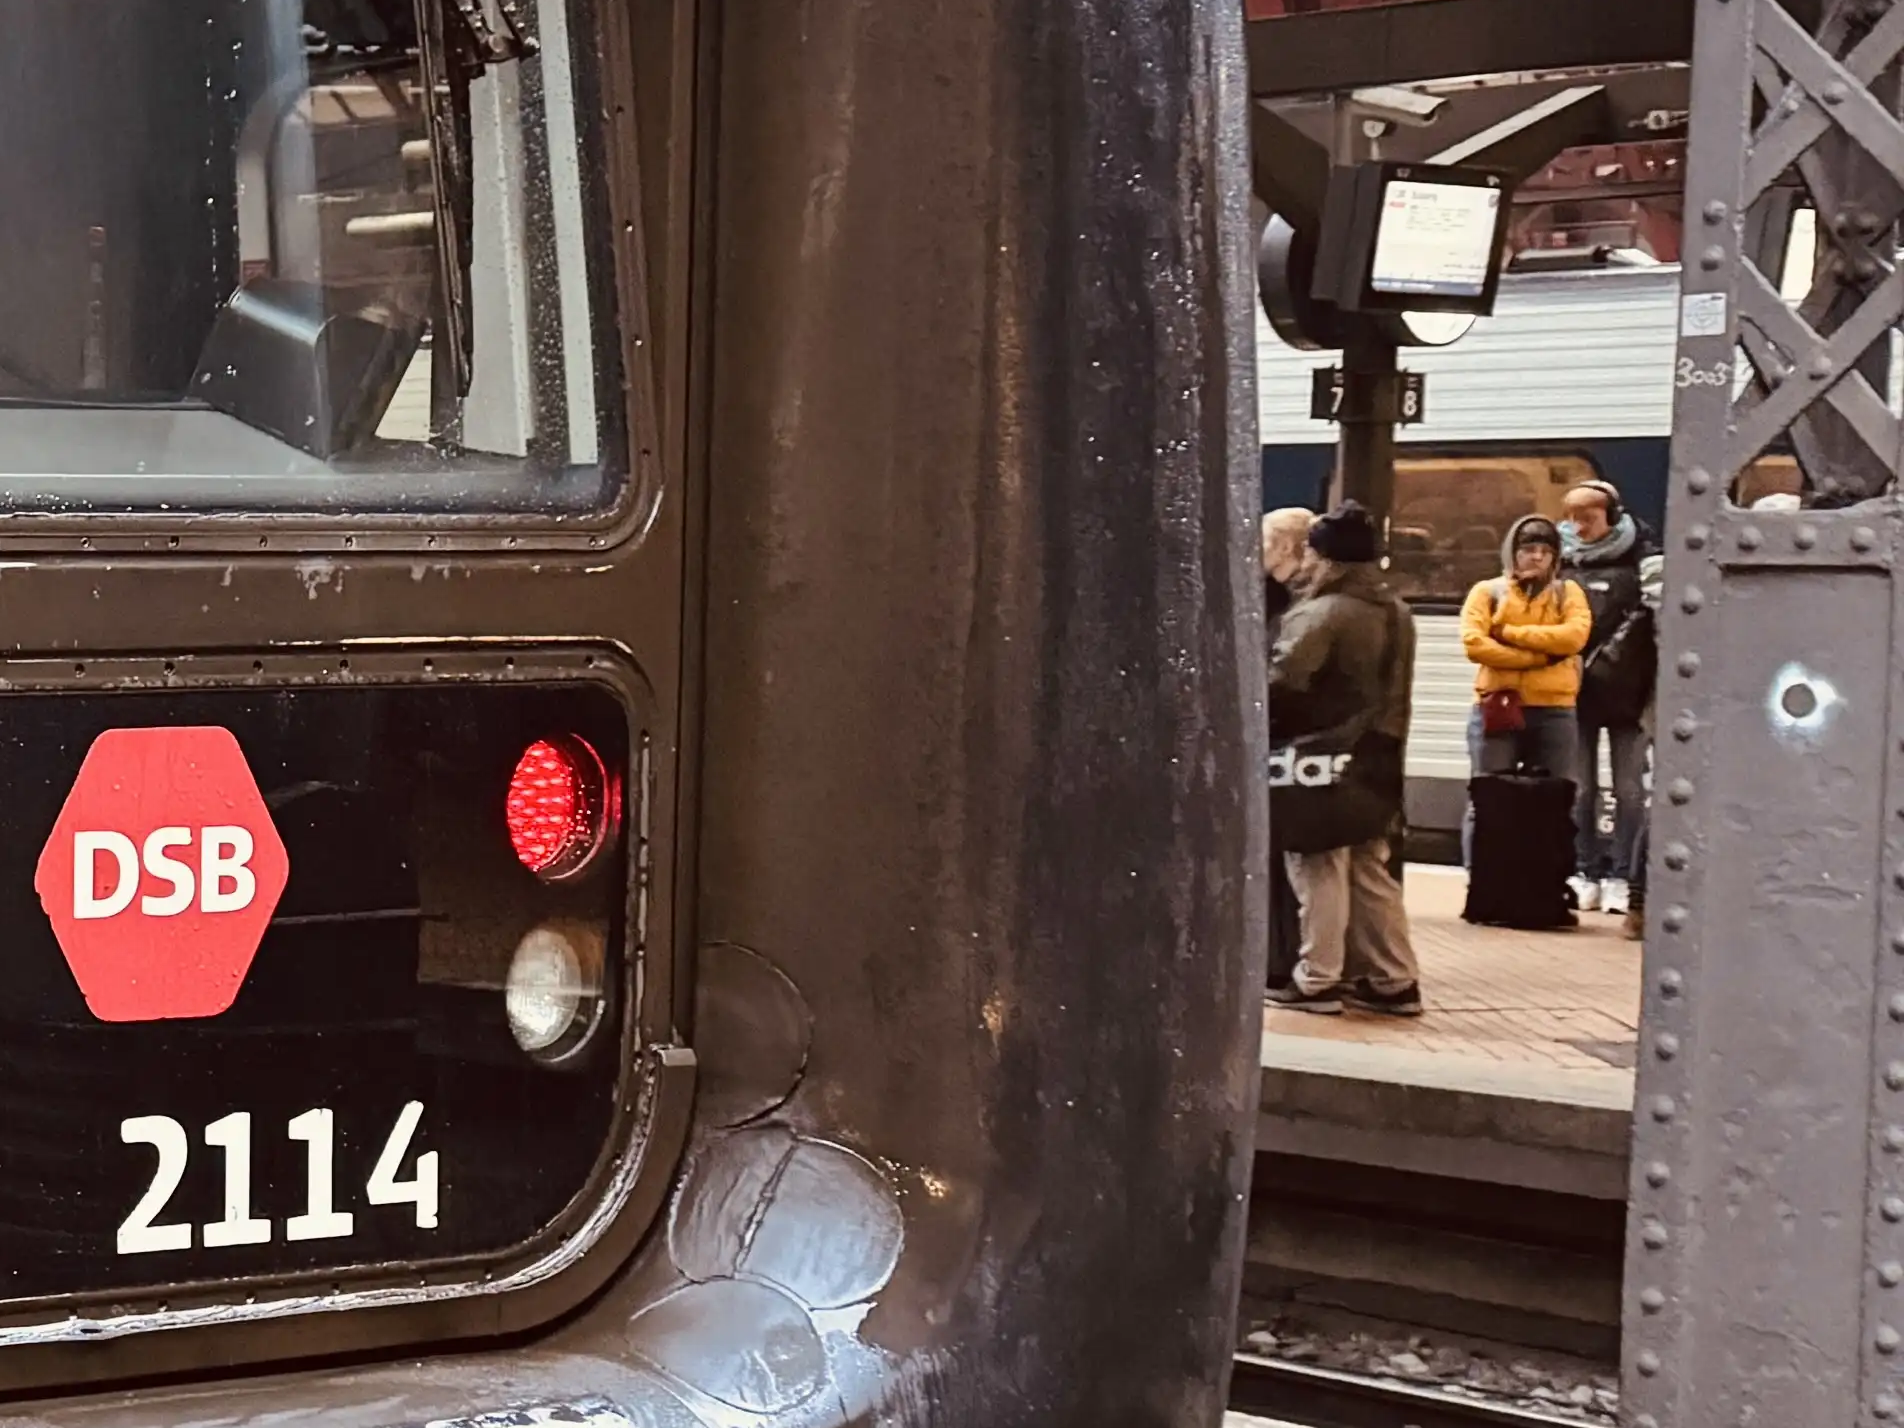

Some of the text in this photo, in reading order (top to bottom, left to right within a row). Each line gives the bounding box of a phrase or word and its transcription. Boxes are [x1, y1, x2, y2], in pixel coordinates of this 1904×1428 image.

[1330, 386, 1344, 414] 7
[1403, 390, 1417, 417] 8
[73, 825, 257, 920] DSB
[116, 1099, 440, 1255] 2114
